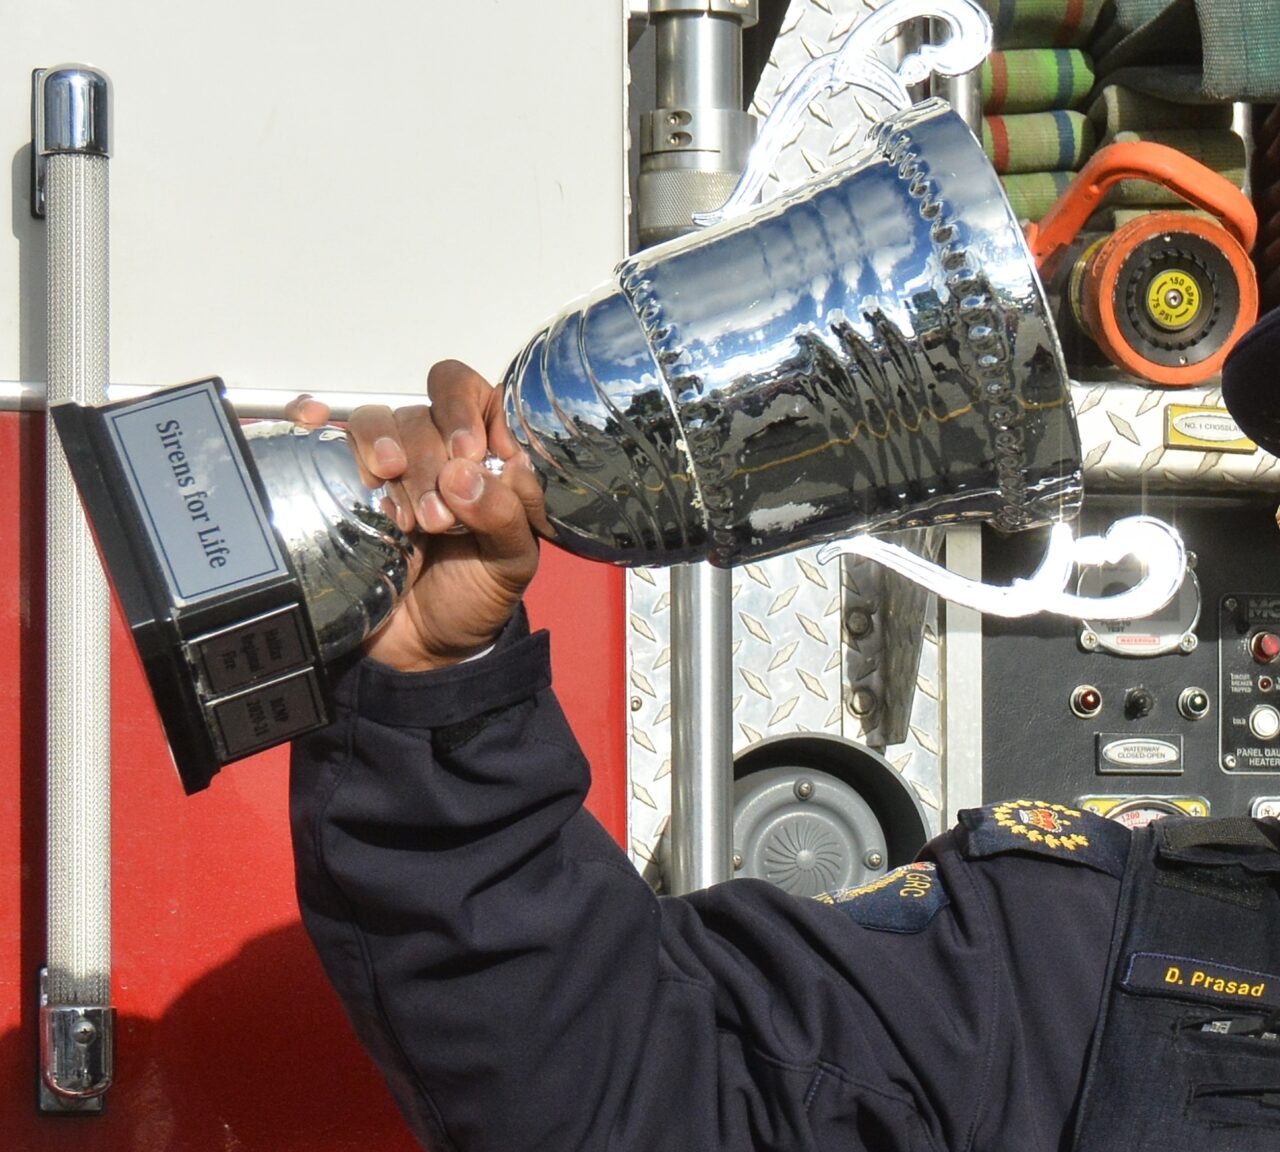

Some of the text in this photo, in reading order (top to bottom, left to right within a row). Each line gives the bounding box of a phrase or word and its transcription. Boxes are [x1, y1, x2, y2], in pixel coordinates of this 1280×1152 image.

[1169, 276, 1194, 307] 150 GPM
[1158, 309, 1174, 323] PSI
[1184, 421, 1198, 430] NO.
[1204, 422, 1240, 431] CROSSLA
[156, 419, 231, 570] Sirens for Life
[1117, 751, 1166, 759] CLOSED-OPEN
[1236, 748, 1263, 757] PANEL
[1120, 810, 1141, 824] 1200
[1164, 966, 1266, 997] D. Prasad
